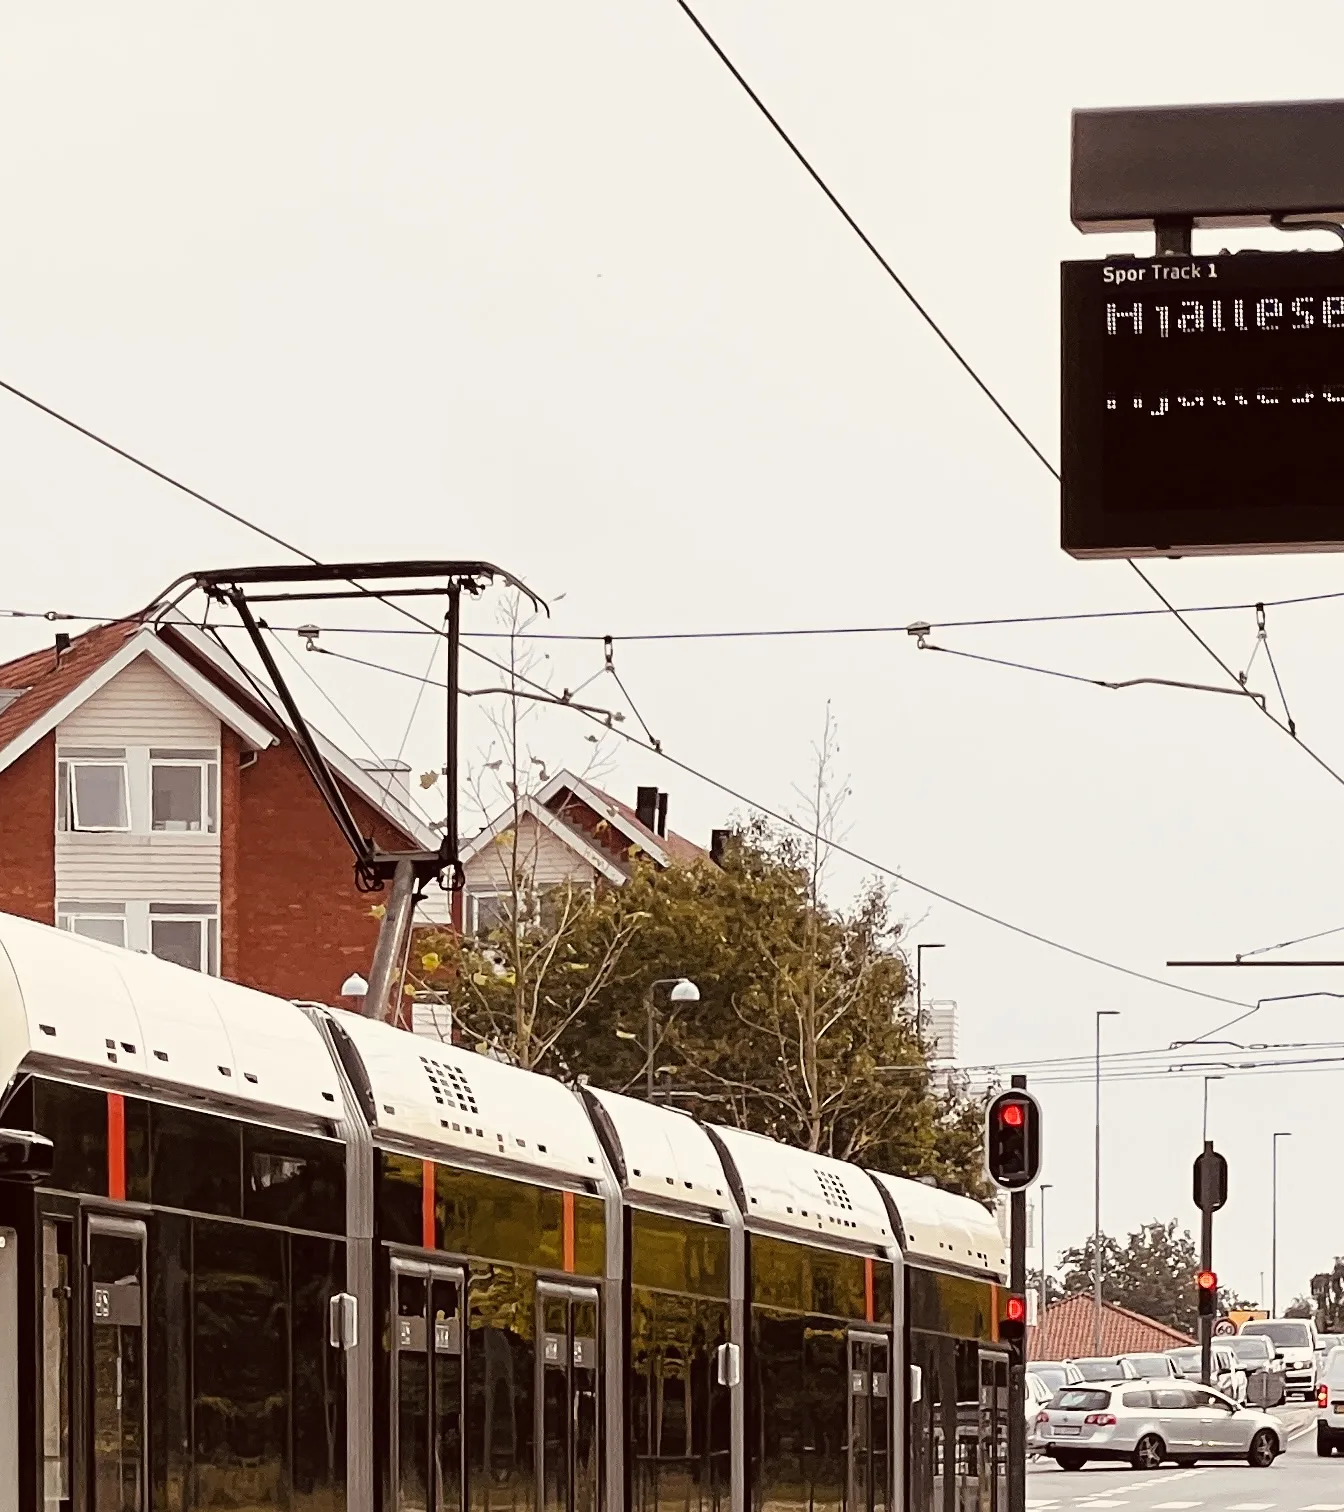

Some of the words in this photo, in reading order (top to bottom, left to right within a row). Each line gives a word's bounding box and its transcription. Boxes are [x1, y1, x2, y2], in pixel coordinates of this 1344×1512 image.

[1102, 266, 1147, 285] Spor
[1151, 263, 1202, 281] Track
[1207, 263, 1219, 278] 1
